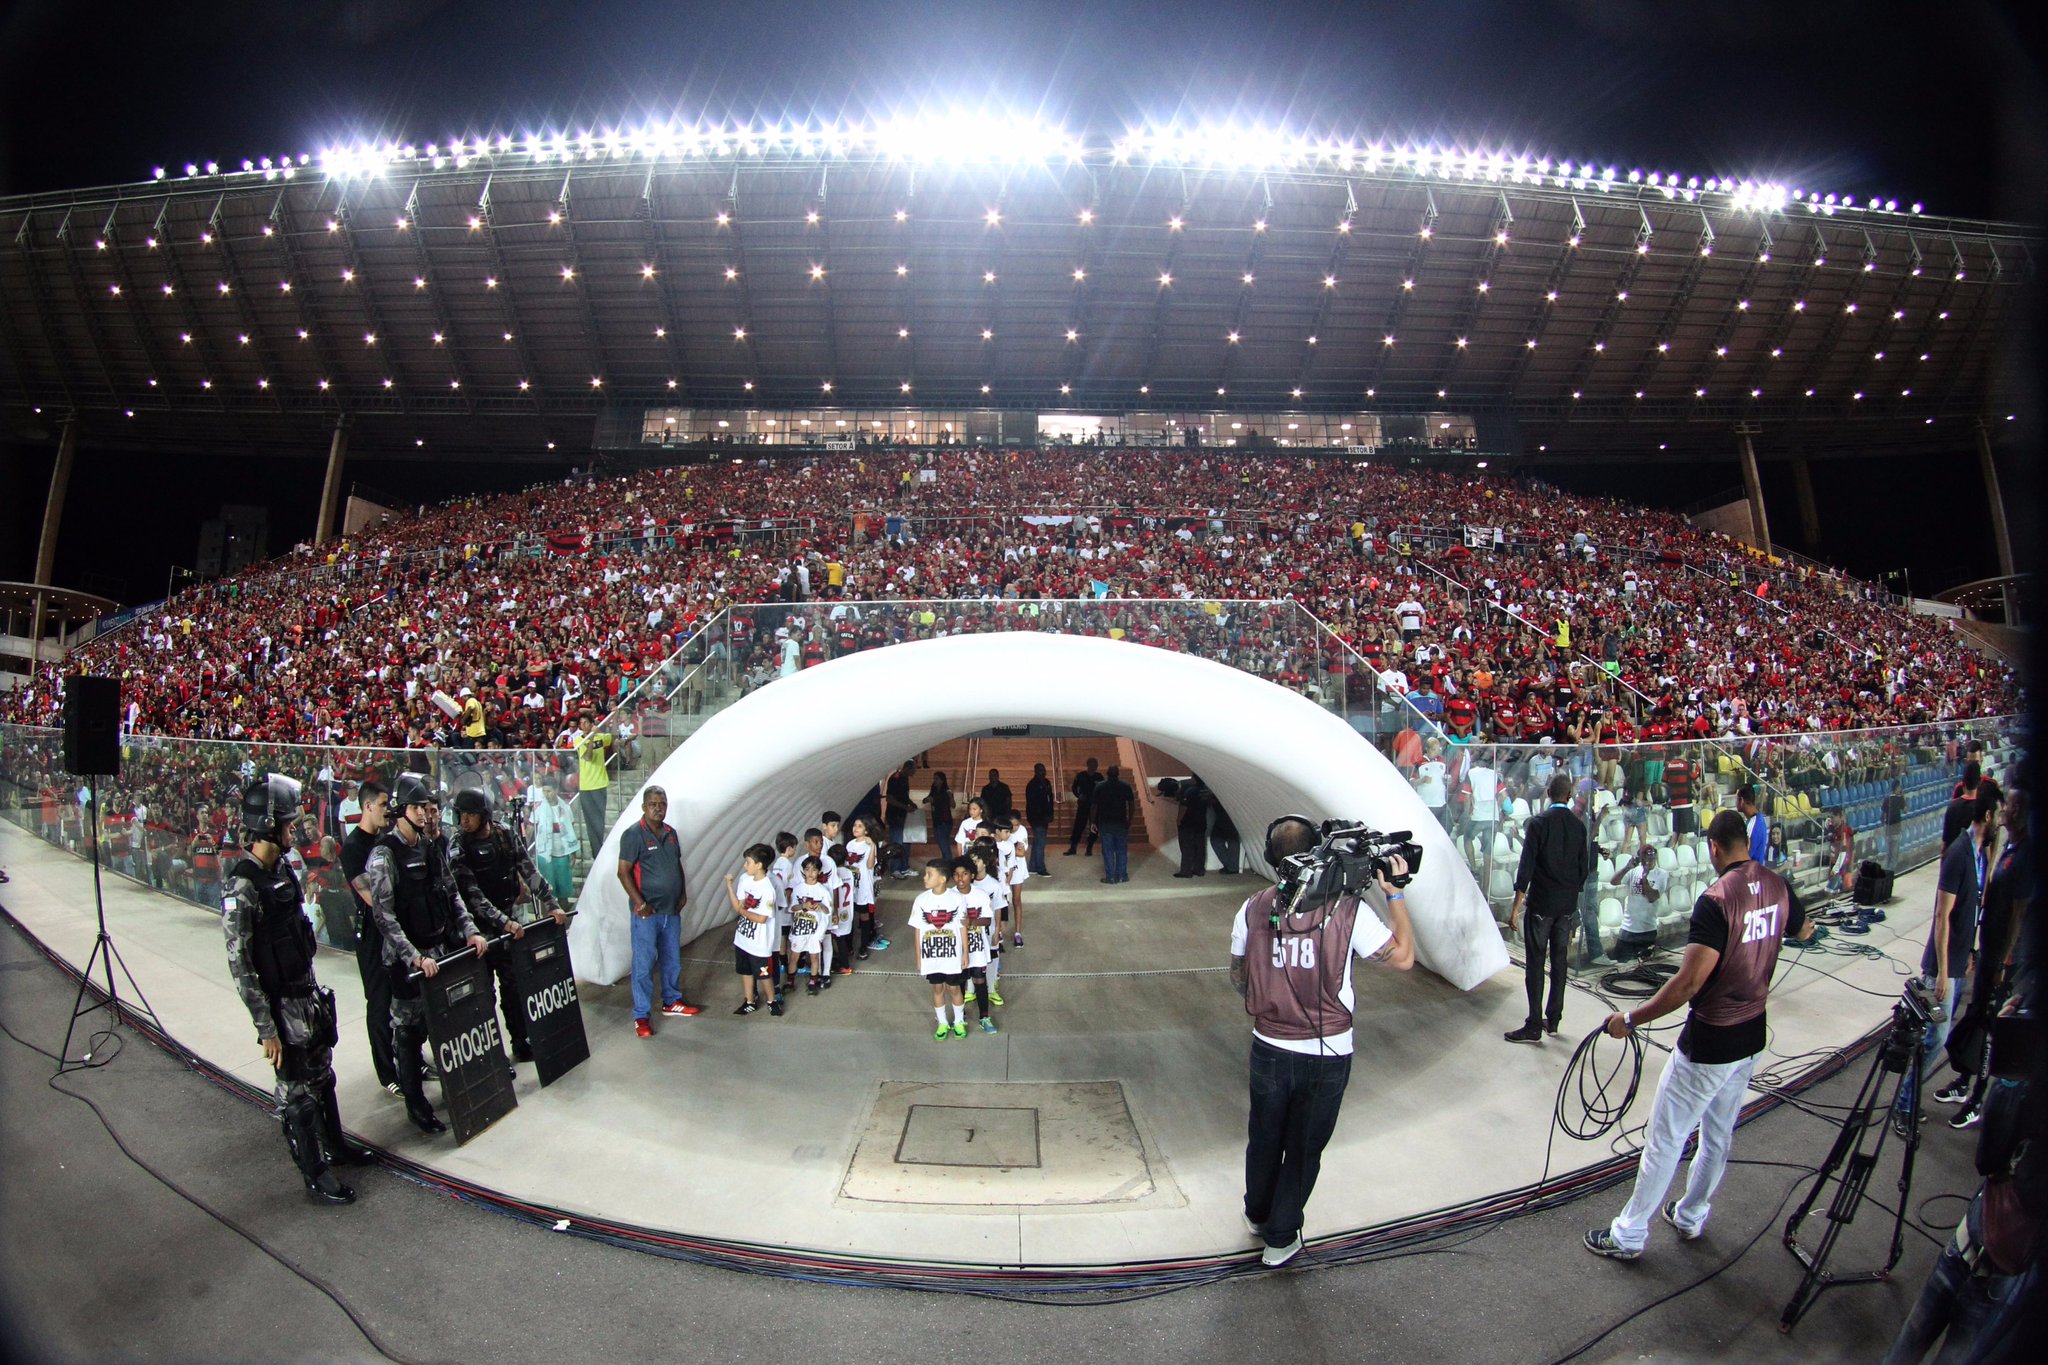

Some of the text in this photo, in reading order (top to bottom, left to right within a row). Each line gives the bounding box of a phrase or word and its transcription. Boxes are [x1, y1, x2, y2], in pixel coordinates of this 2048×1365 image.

[827, 442, 854, 450] SETOR A
[1349, 446, 1374, 454] SETOR B
[1747, 881, 1760, 895] TV
[1742, 904, 1778, 943] 2157
[922, 947, 957, 959] NEGRA
[1272, 937, 1315, 968] 518
[527, 977, 577, 1022] CHOQUE
[439, 1017, 499, 1073] CHOQUE
